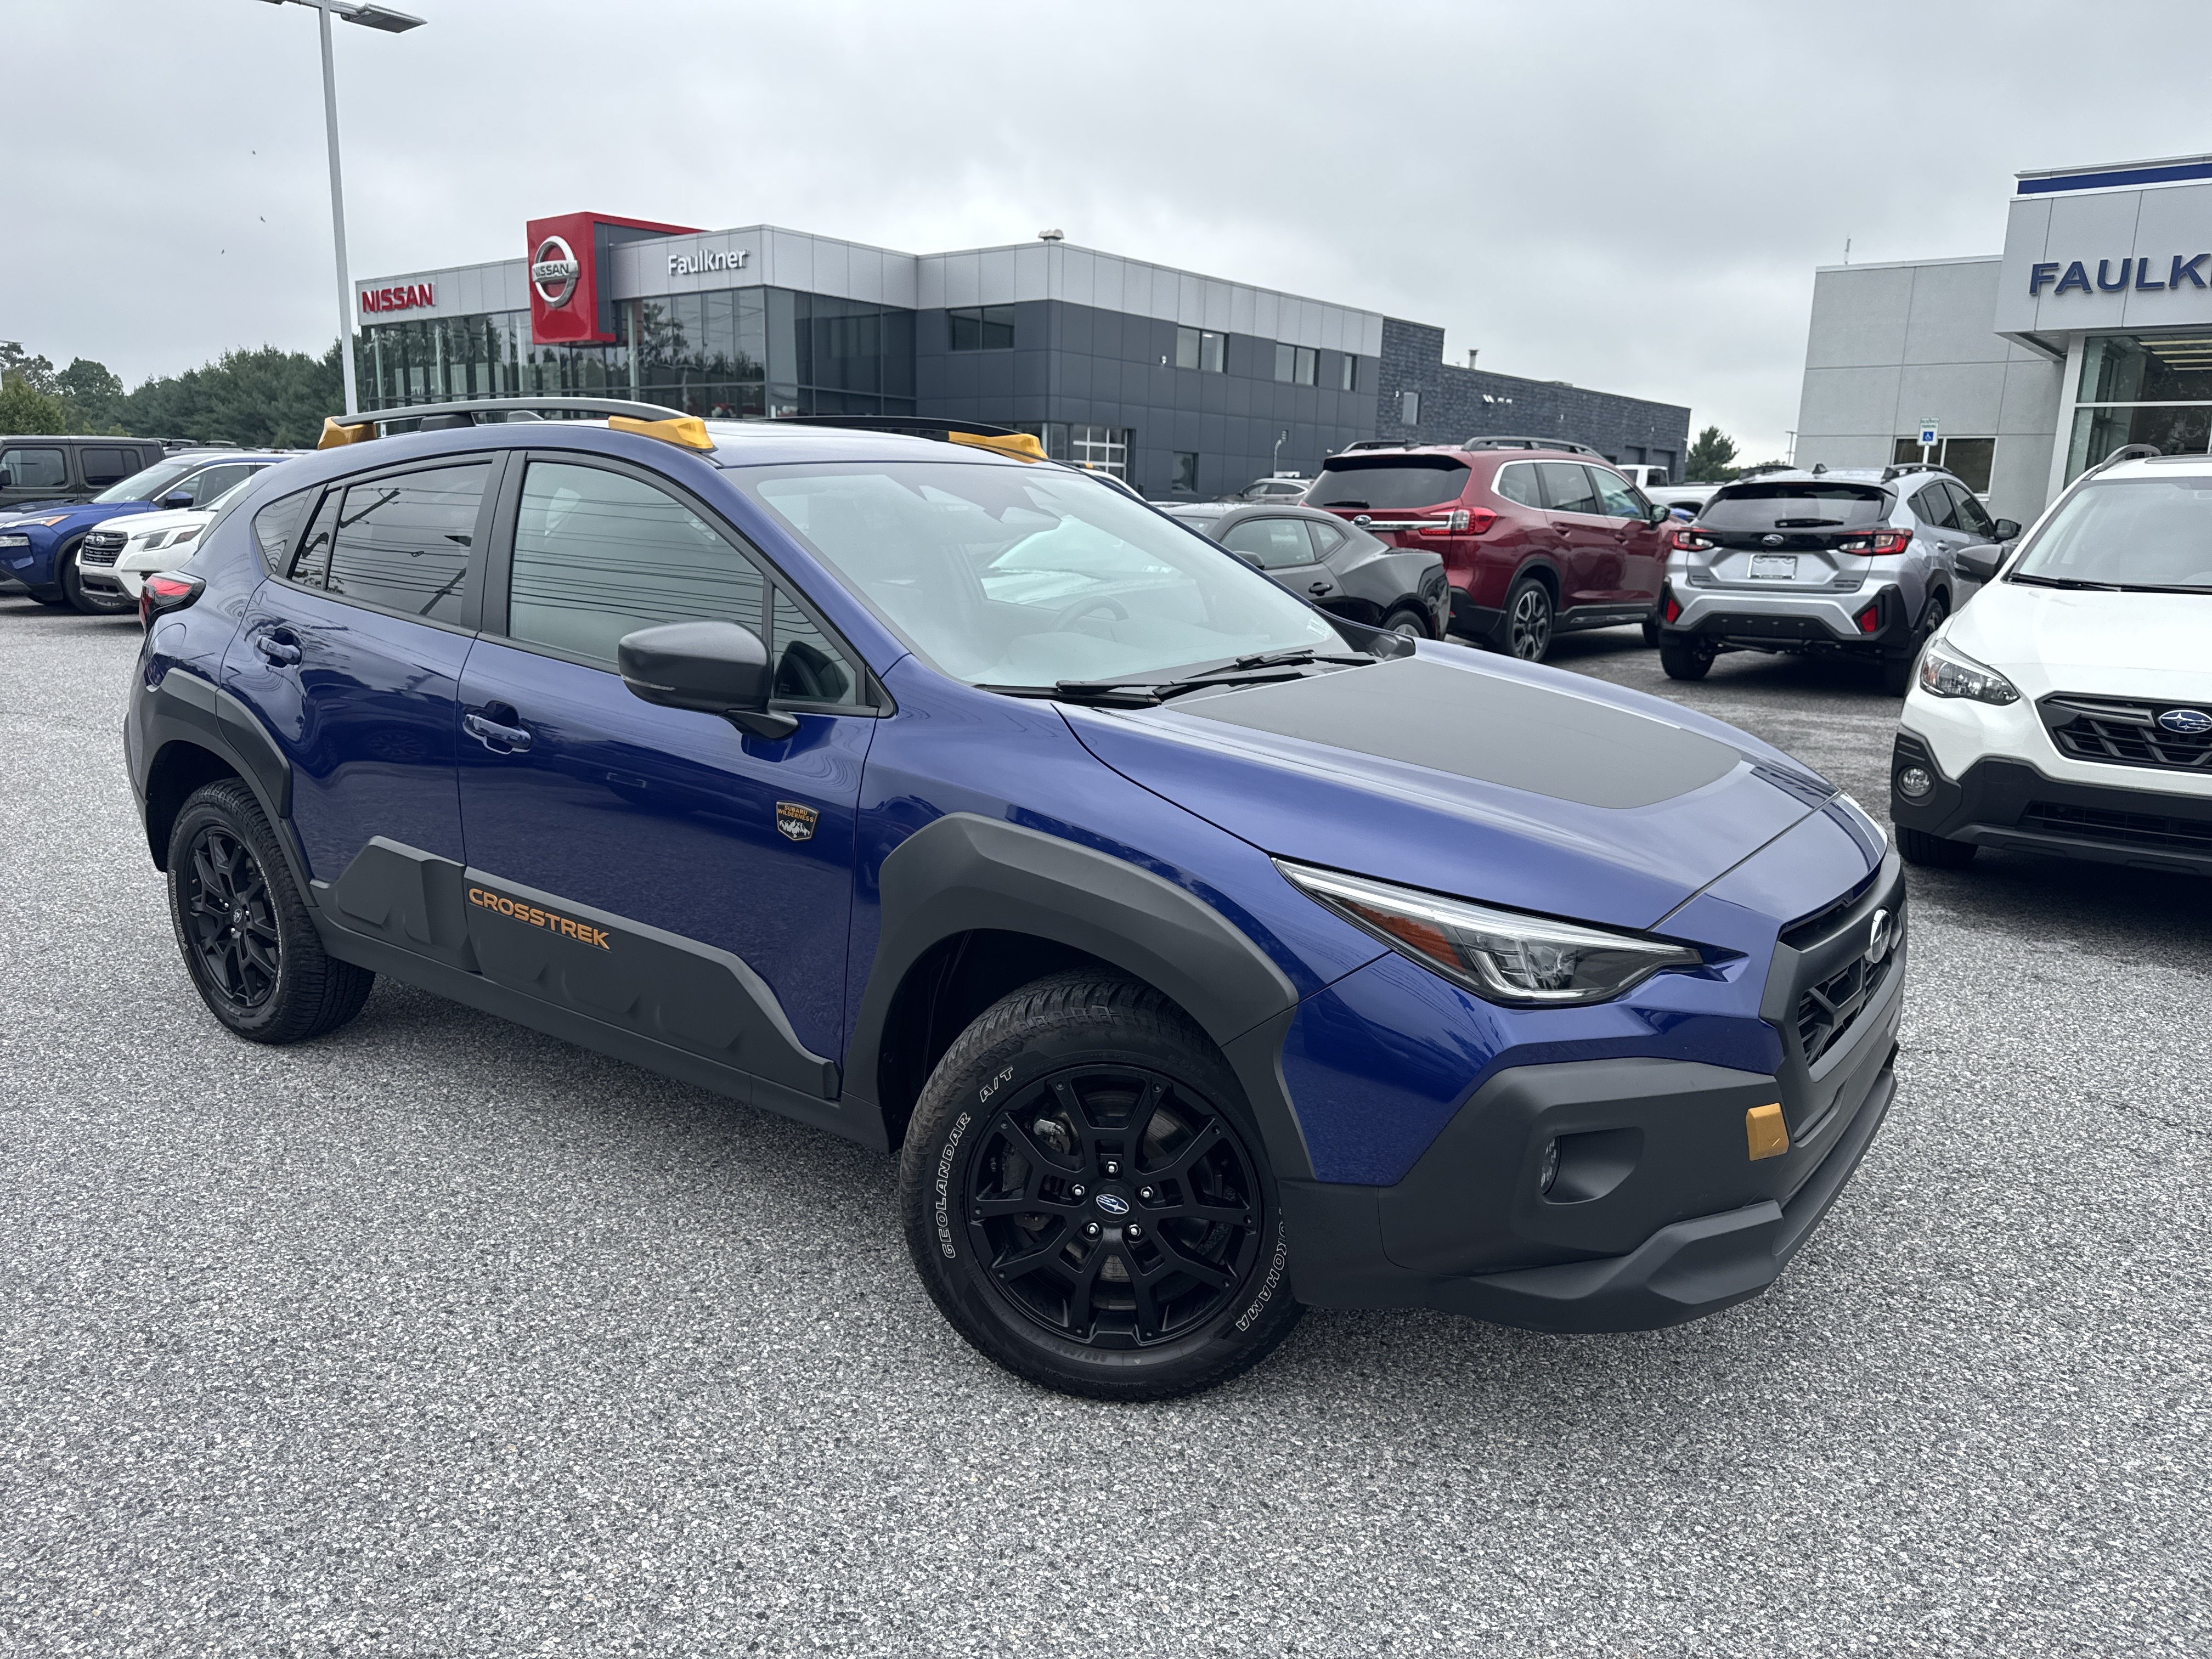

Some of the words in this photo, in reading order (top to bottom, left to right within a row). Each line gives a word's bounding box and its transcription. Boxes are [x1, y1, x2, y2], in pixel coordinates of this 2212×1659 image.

[533, 263, 569, 278] NISSAN
[668, 249, 747, 275] Faulkner
[2029, 253, 2212, 294] FAULK
[362, 283, 434, 313] NISSAN
[777, 808, 815, 822] WILDERNESS
[784, 805, 808, 815] SUBARU
[171, 869, 188, 952] YOKOHAMA
[469, 888, 610, 950] CROSSTREK
[935, 1111, 972, 1259] GEOLANDAR
[979, 1066, 1014, 1103] A/T
[1235, 1207, 1287, 1332] OKOHAMA
